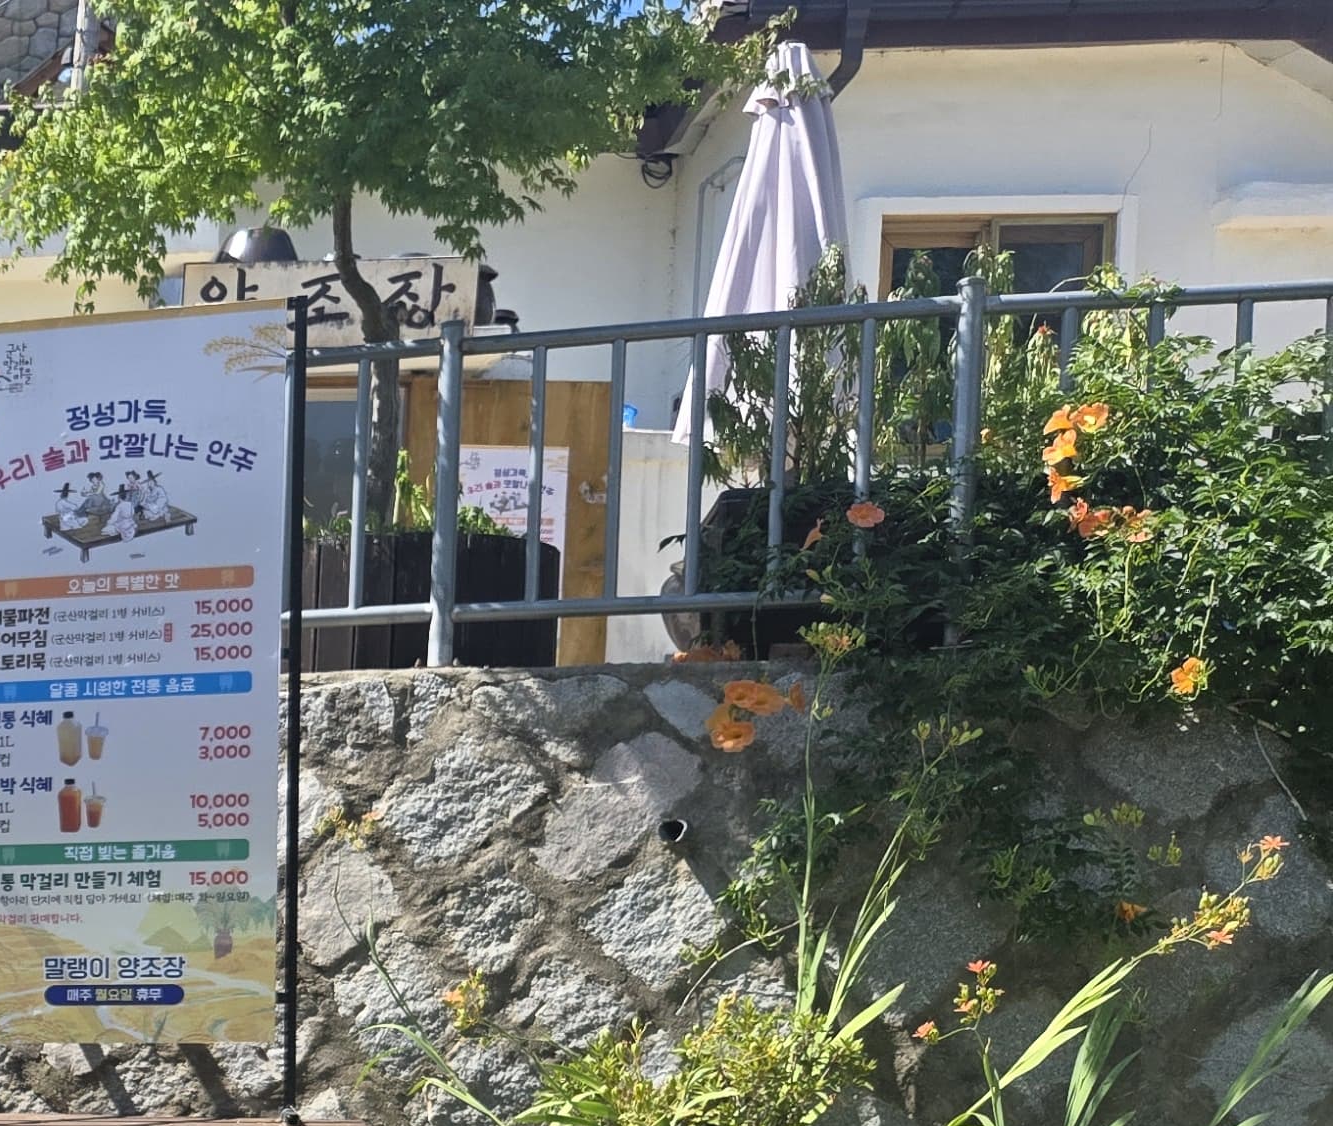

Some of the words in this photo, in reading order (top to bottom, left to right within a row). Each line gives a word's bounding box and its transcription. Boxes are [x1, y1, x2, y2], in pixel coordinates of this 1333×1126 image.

[66, 400, 172, 431] 정성가득,
[42, 438, 90, 472] 술과
[99, 433, 198, 462] 맛깔나는
[206, 440, 258, 473] 안주
[67, 577, 110, 594] 오늘의
[116, 574, 160, 591] 특별한
[164, 573, 180, 589] 맛
[194, 598, 253, 616] 15,000
[190, 621, 253, 639] 25,000
[194, 645, 252, 662] 15,000
[49, 682, 78, 699] 달콤
[82, 680, 127, 697] 시원한
[131, 678, 162, 695] 전통
[165, 677, 196, 693] 음료
[19, 709, 53, 727] 식혜
[199, 725, 251, 742] 7,000
[198, 744, 251, 761] 3,000
[19, 776, 53, 793] 식혜
[190, 793, 250, 810] 10,000
[198, 812, 250, 829] 5,000
[64, 846, 93, 861] 직접
[132, 843, 176, 860] 즐거움
[19, 873, 69, 890] 막걸리
[73, 870, 123, 889] 만들기
[127, 870, 162, 889] 체험
[189, 871, 248, 887] 15,000
[44, 957, 110, 979] 말랭이
[117, 957, 186, 979] 양조장
[66, 988, 92, 1001] 매주
[95, 988, 134, 1001] 월요일
[136, 988, 162, 1001] 휴무
